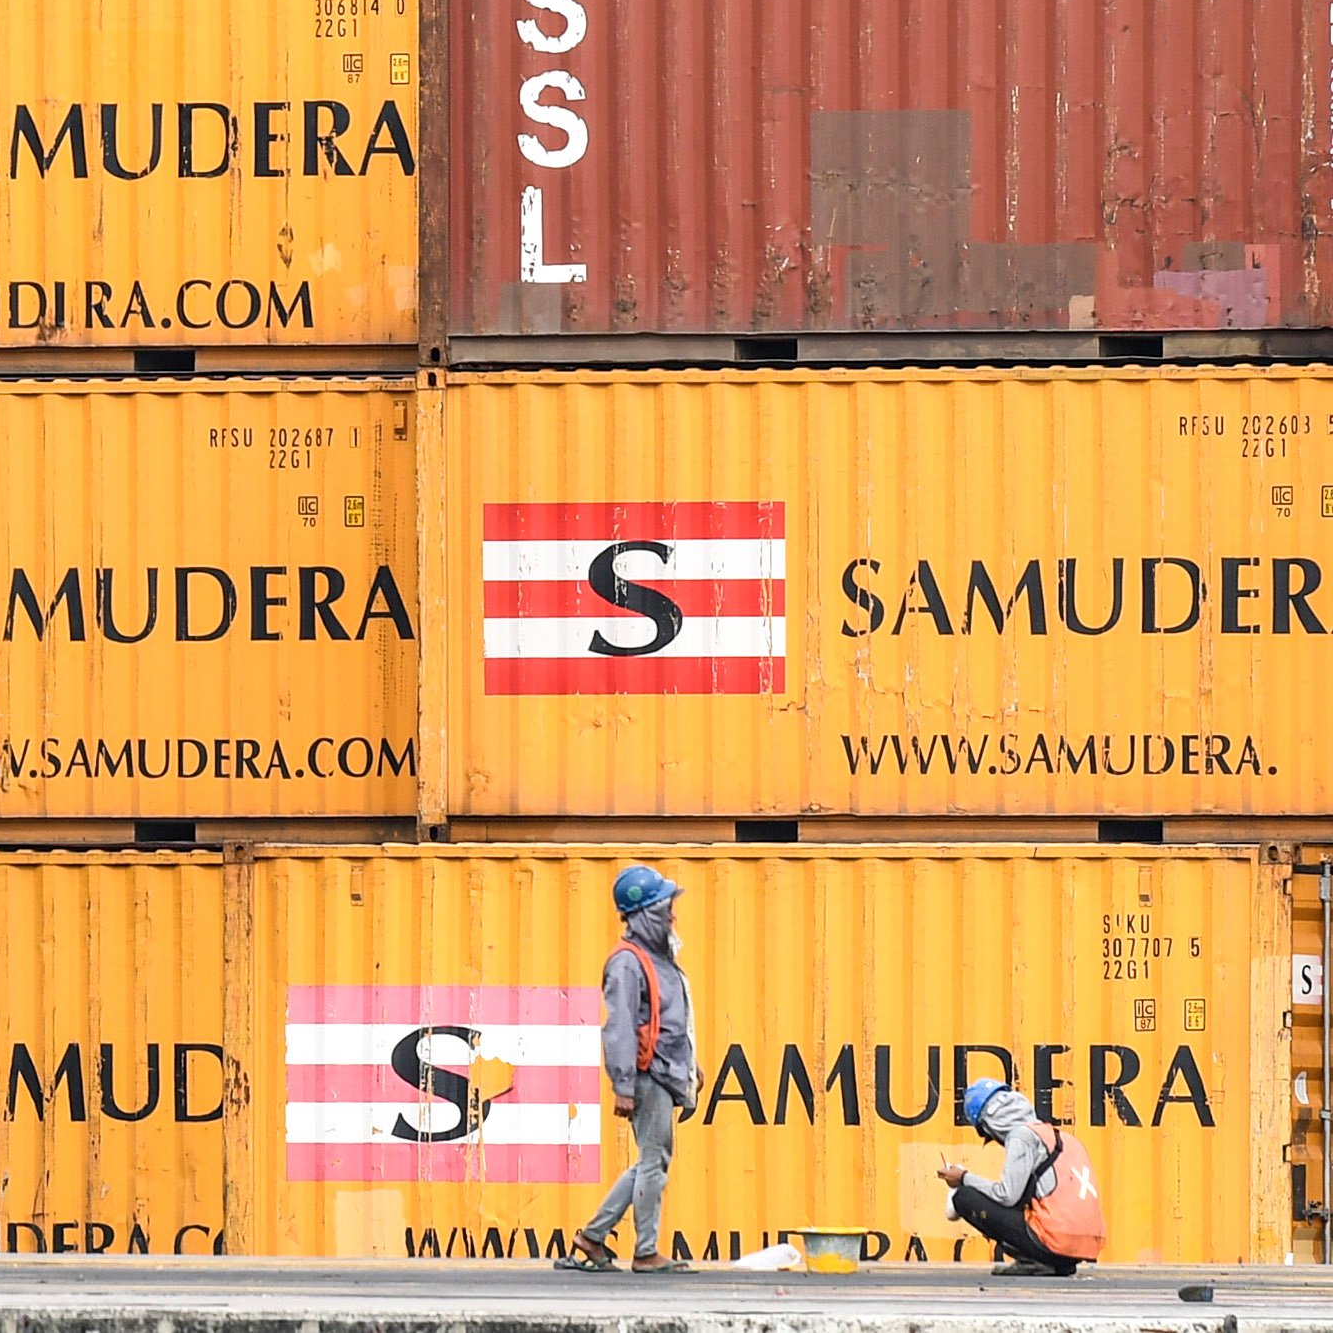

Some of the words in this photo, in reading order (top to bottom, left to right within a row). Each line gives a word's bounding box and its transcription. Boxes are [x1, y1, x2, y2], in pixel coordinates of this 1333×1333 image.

[314, 19, 358, 38] 22G1
[347, 74, 360, 84] 87
[1178, 415, 1225, 436] RFSU
[209, 427, 253, 448] RFSU
[269, 427, 333, 448] 202687
[1241, 438, 1286, 458] 22G1
[269, 449, 311, 469] 22G1
[302, 517, 316, 528] 70
[1276, 507, 1291, 518] 70
[587, 539, 684, 656] S
[840, 557, 1333, 638] SAMUDER
[1102, 914, 1151, 934] SIKU
[1102, 937, 1173, 958] 307707
[1190, 936, 1201, 958] 5
[1102, 959, 1150, 980] 22G1
[1301, 963, 1314, 997] S
[1139, 1018, 1153, 1029] 87
[391, 1025, 491, 1142] S
[676, 1043, 1216, 1128] AMUDERA
